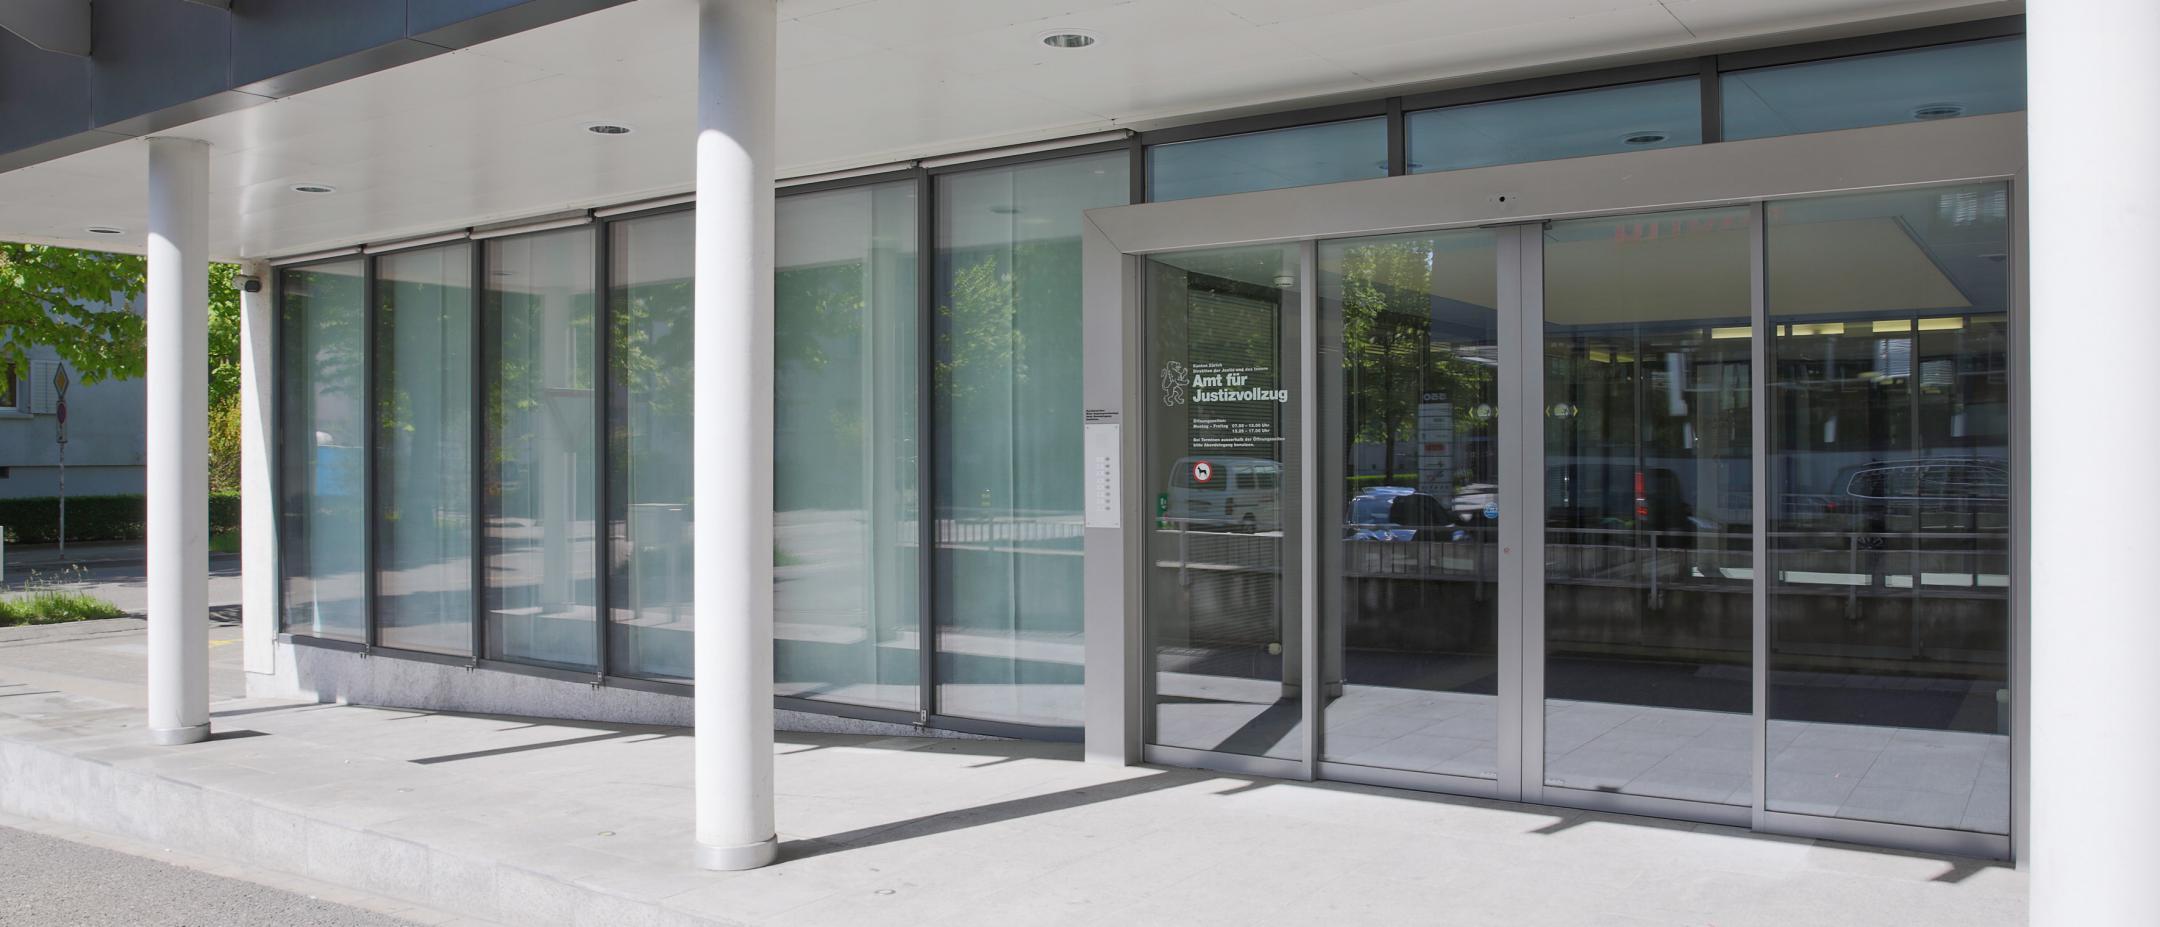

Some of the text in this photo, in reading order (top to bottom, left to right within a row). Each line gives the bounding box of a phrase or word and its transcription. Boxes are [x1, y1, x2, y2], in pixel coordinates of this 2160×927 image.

[1192, 373, 1248, 387] Amt für
[1193, 387, 1288, 403] Justizvollzug
